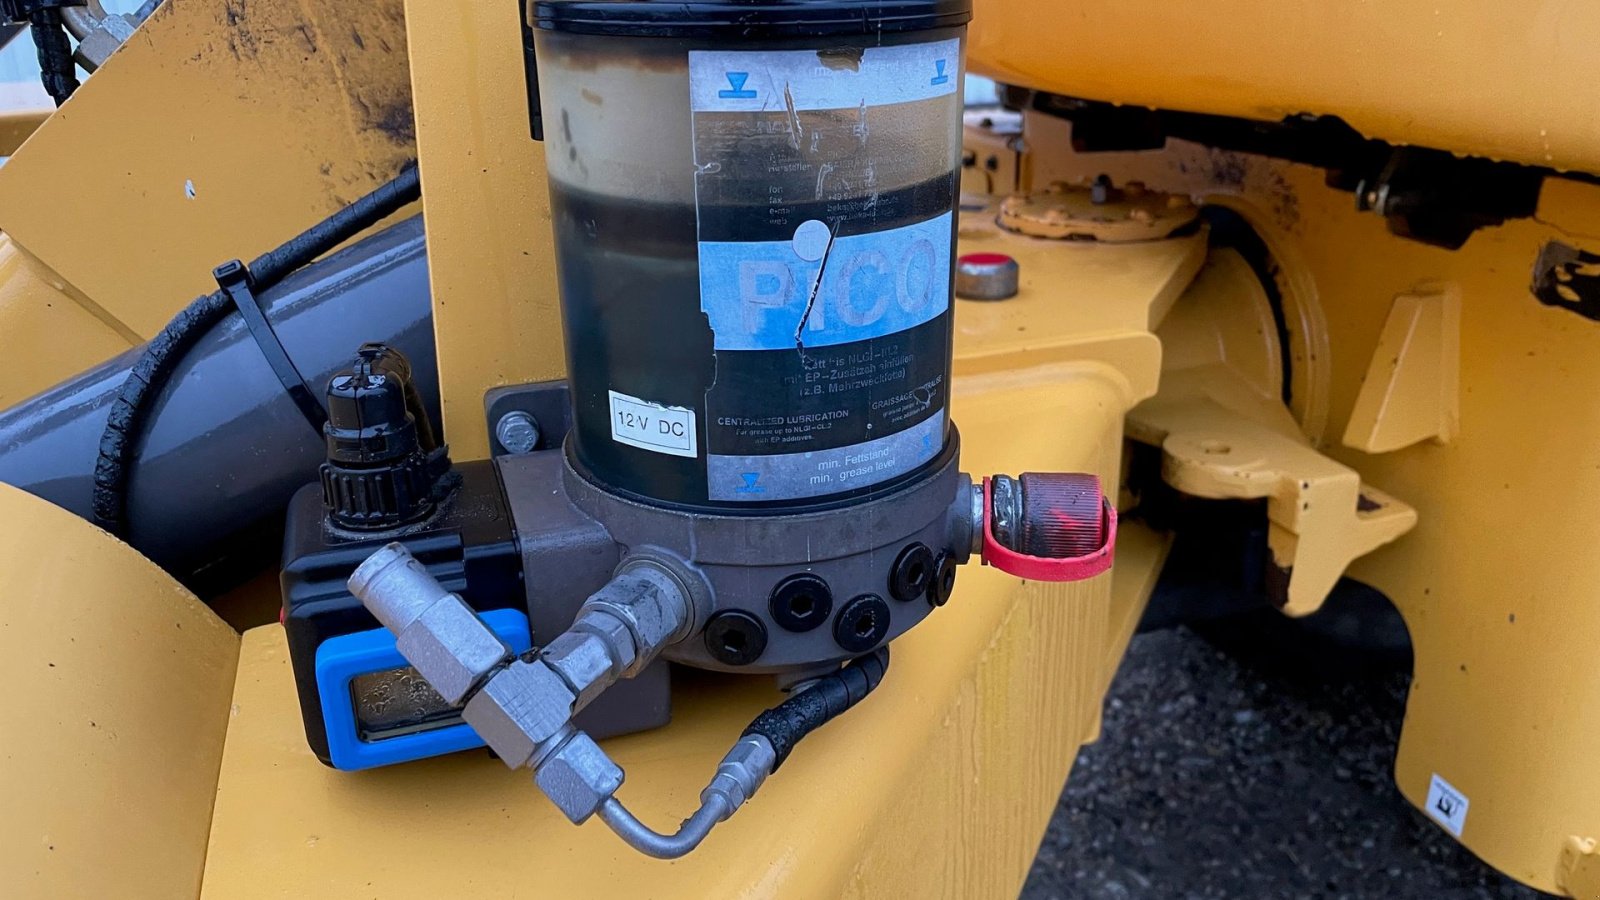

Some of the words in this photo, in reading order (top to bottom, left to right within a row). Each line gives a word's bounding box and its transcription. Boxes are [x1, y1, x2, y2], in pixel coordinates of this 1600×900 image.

[739, 239, 936, 334] PICO
[659, 419, 684, 437] DC
[786, 409, 849, 424] LUBRICATION
[809, 473, 834, 485] min.
[839, 465, 873, 482] grease
[875, 457, 896, 471] level
[818, 459, 841, 471] min.
[845, 446, 890, 466] Fettstand
